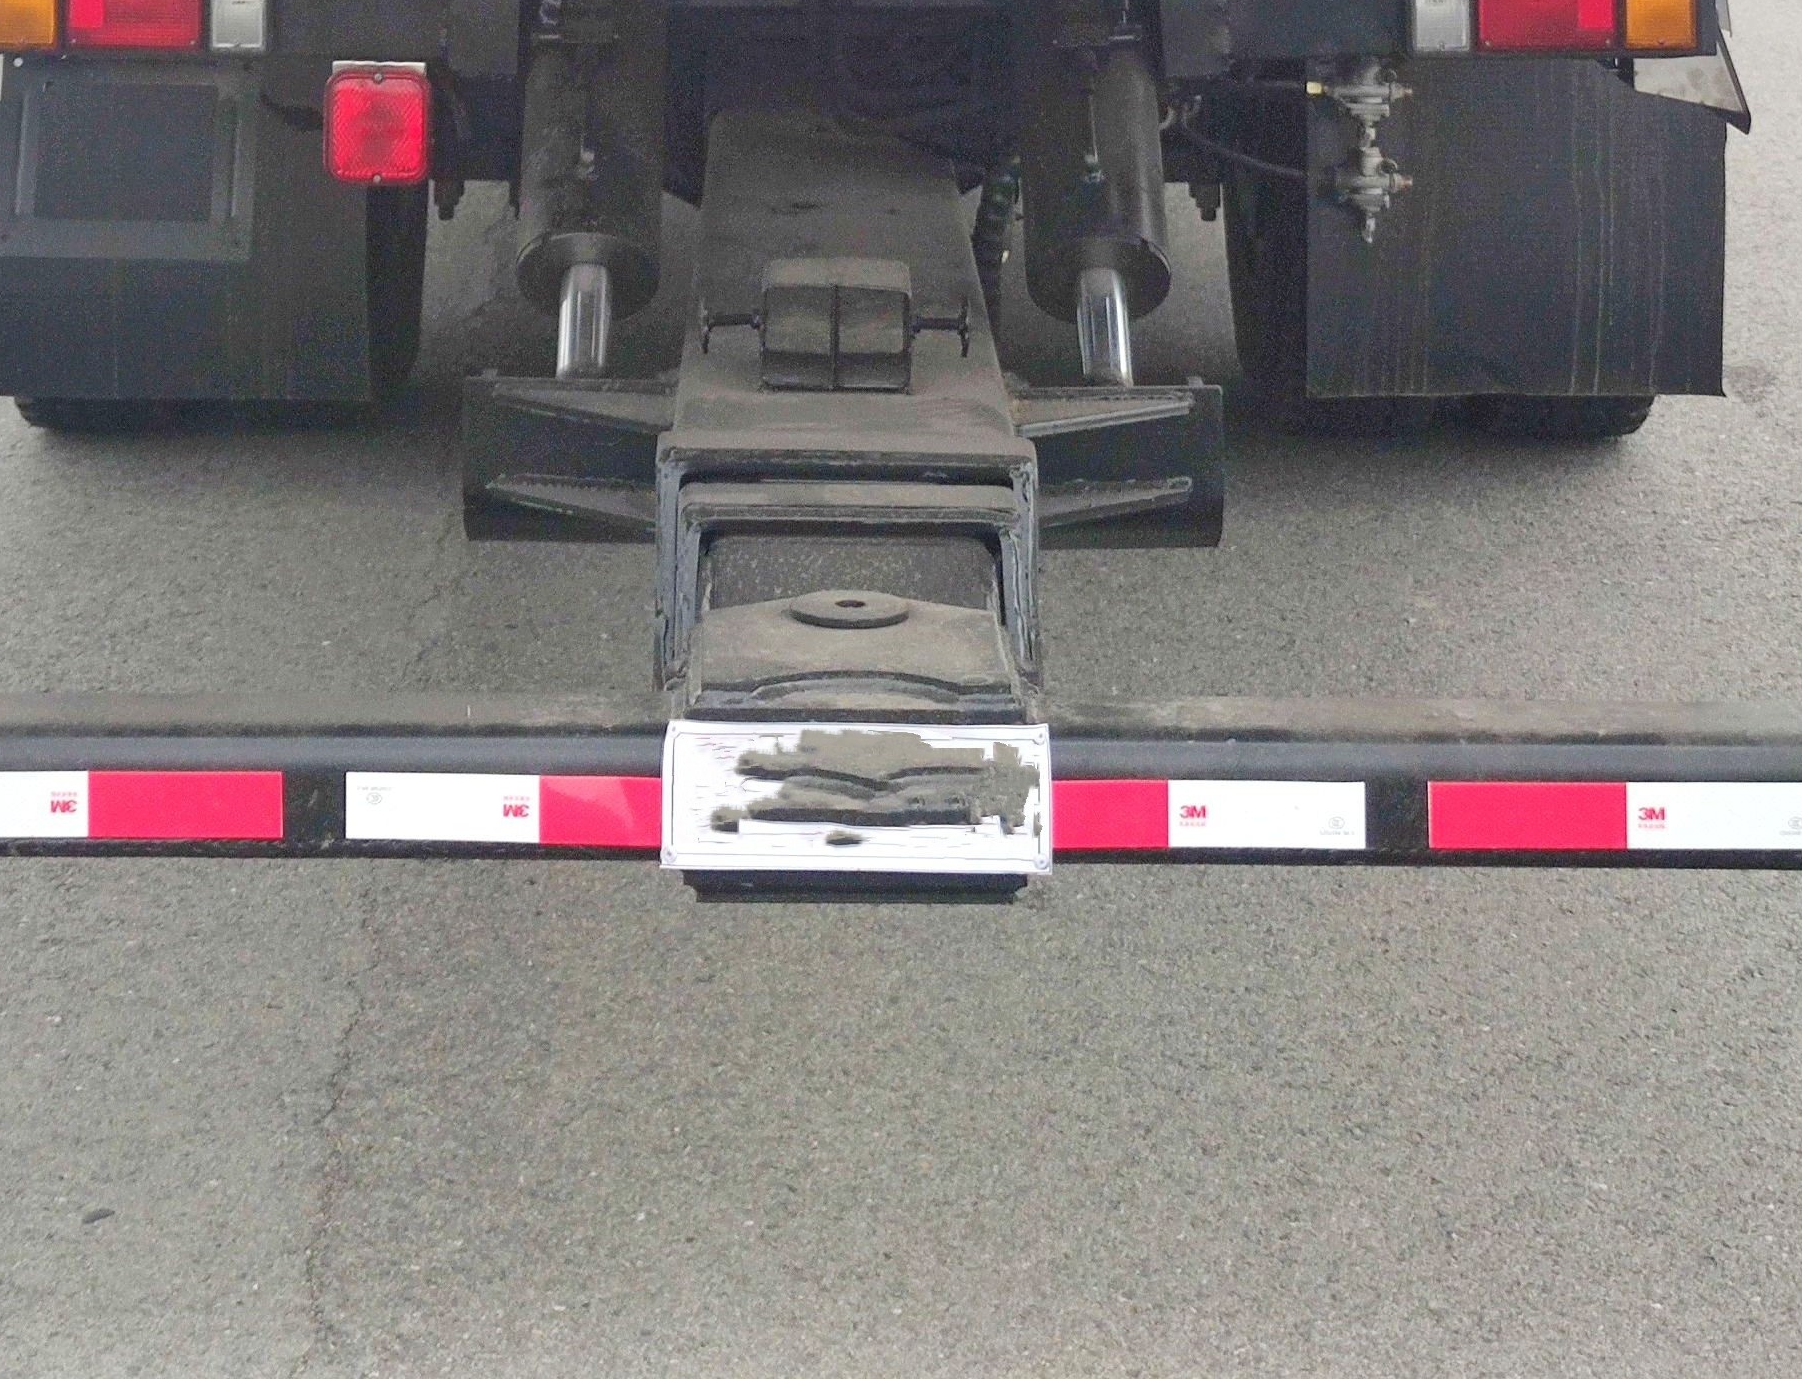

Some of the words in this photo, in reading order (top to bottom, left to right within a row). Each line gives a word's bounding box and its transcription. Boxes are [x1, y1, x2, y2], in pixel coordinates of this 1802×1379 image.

[50, 800, 77, 814] 3M
[503, 804, 529, 818] 3M
[1180, 805, 1207, 819] 3M
[1638, 807, 1665, 821] 3M
